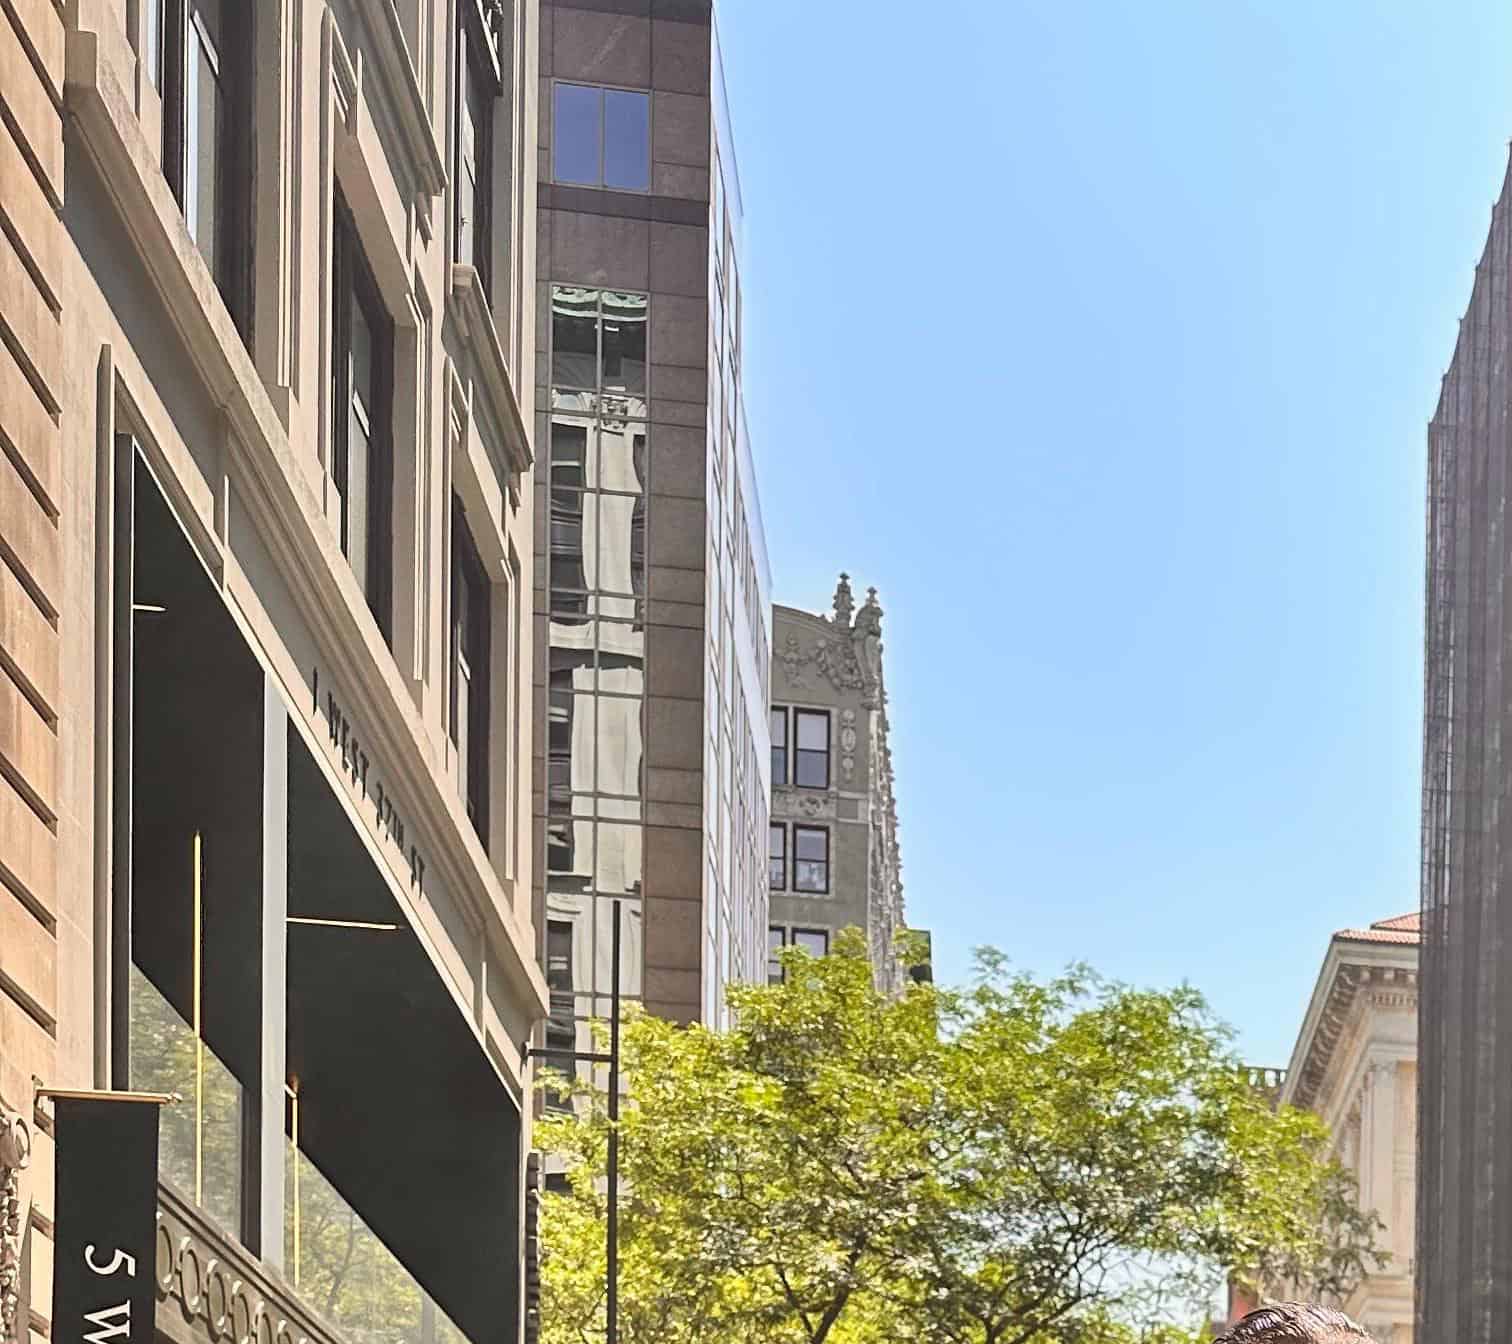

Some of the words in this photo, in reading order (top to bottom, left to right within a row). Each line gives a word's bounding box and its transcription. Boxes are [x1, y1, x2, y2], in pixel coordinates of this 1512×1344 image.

[327, 689, 370, 803] WEST
[410, 844, 426, 901] ST
[85, 1245, 136, 1278] 5
